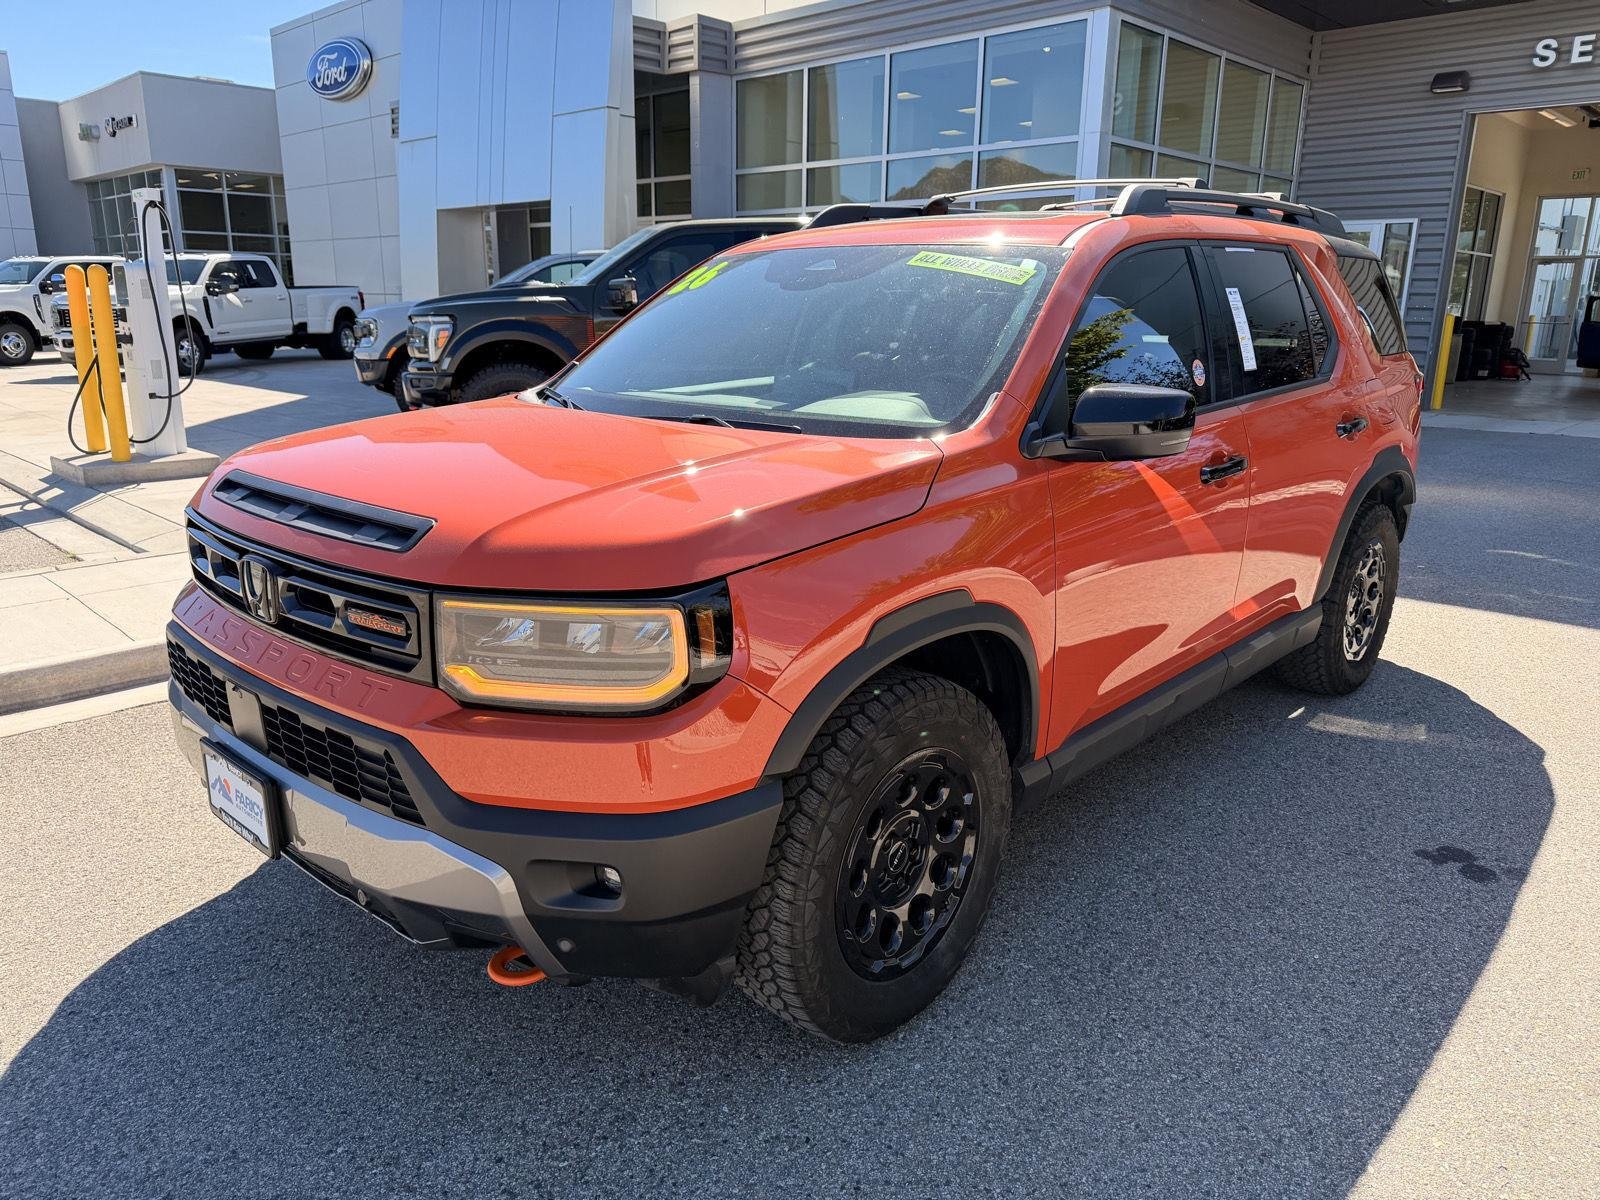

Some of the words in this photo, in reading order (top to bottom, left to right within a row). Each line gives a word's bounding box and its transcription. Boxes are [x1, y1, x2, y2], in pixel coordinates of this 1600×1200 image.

[1532, 33, 1597, 68] SE
[315, 52, 348, 88] Ford
[1572, 170, 1586, 180] EXIT
[915, 254, 941, 265] ALL
[940, 256, 982, 272] WHEEL
[183, 597, 393, 708] PASSPORT
[235, 788, 264, 820] FARICY
